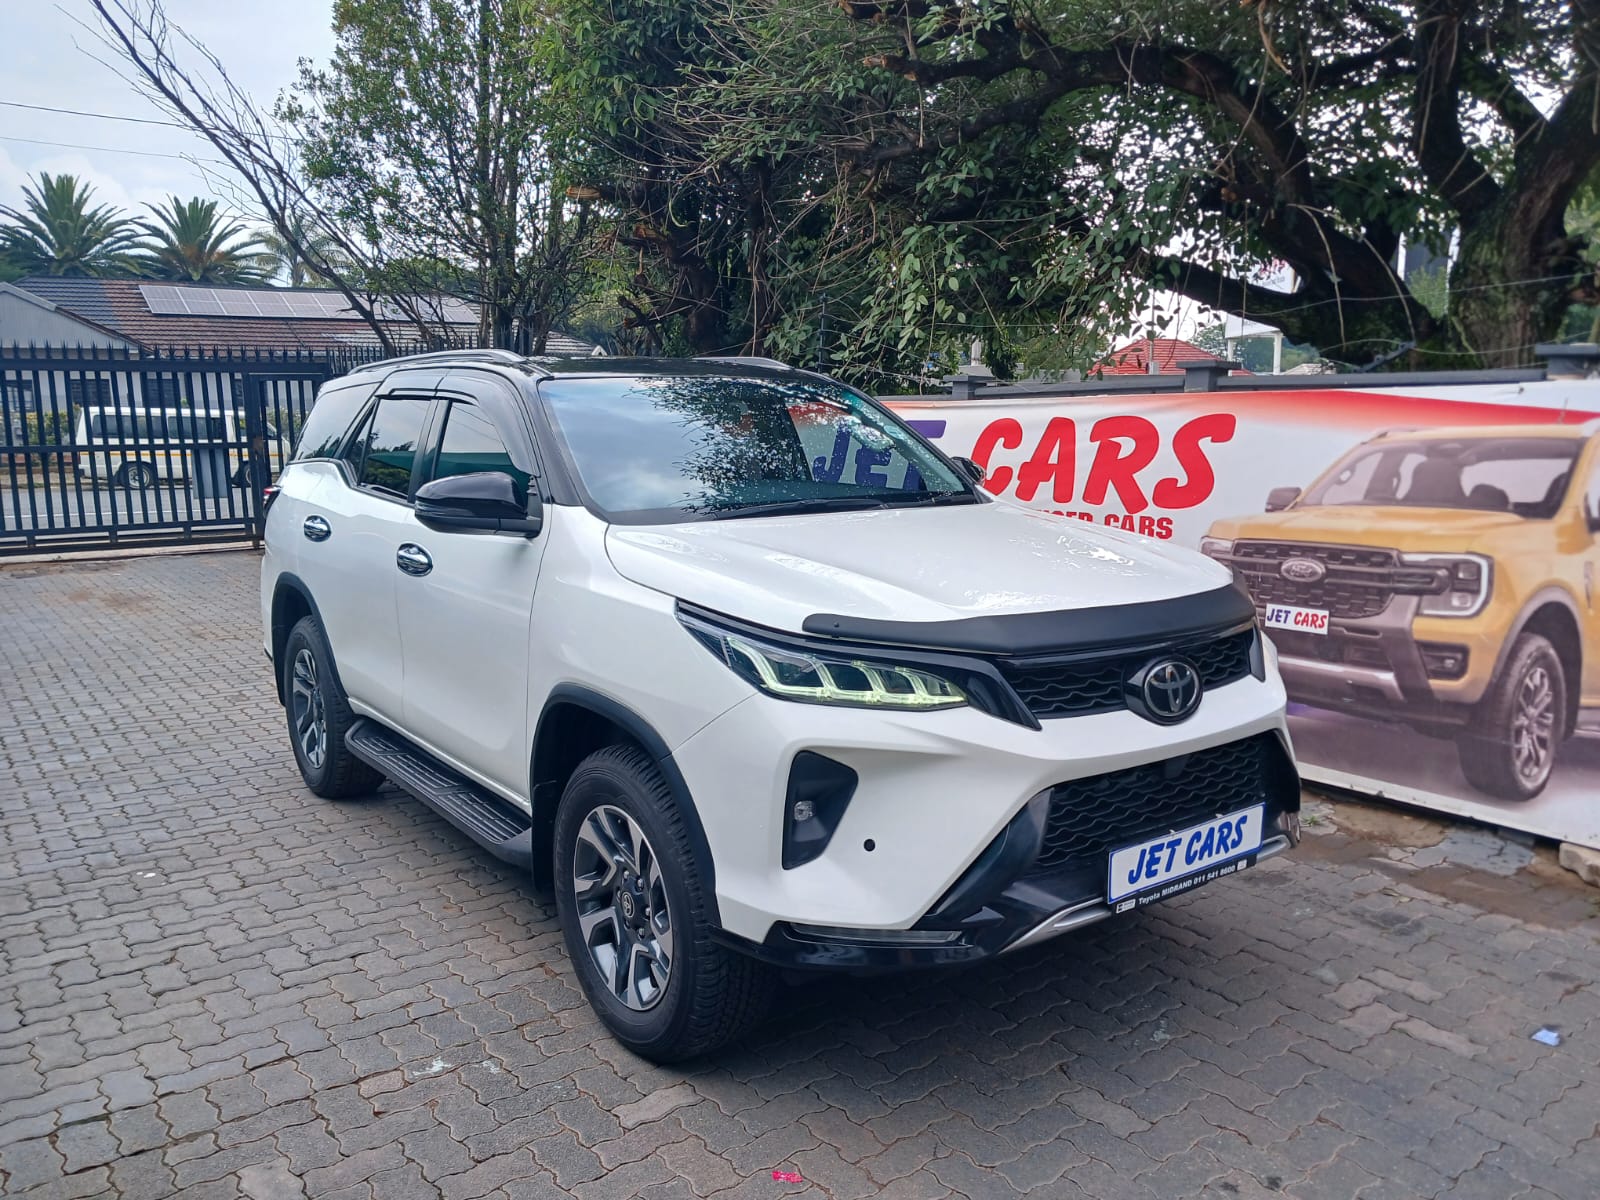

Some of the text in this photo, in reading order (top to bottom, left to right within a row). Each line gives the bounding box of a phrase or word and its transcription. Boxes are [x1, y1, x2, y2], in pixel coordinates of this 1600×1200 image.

[970, 413, 1237, 514] CARS
[1266, 608, 1328, 629] JET CARS
[1128, 815, 1248, 885] JET CARS
[1138, 892, 1161, 904] Toyota
[1161, 879, 1193, 897] MIDRAND
